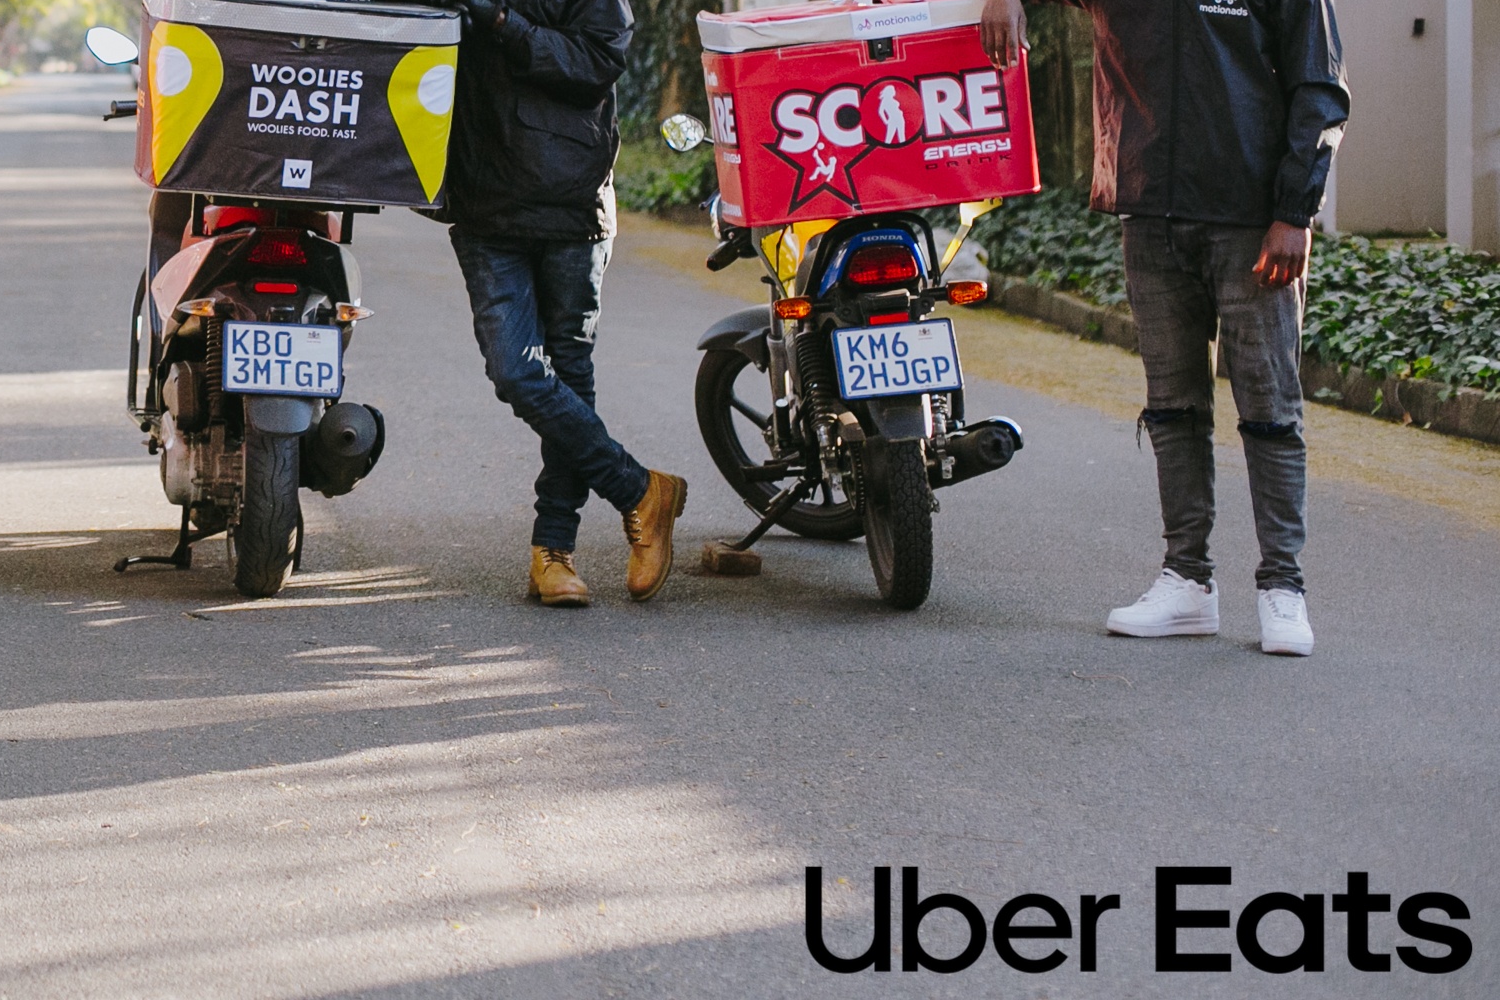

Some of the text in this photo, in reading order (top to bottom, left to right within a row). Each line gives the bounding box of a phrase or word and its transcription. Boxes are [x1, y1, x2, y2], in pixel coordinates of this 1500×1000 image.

[874, 12, 928, 28] motionads
[1200, 4, 1248, 17] motionads
[251, 63, 363, 90] WOOLIES
[248, 86, 360, 125] DASH
[776, 71, 1004, 153] SCORE
[247, 122, 357, 140] WOOLIES FOOD. FAST.
[924, 138, 1011, 160] ENERGY
[290, 168, 306, 179] W
[862, 235, 903, 243] HONDA
[847, 332, 909, 362] KM6
[233, 357, 333, 388] 3MTGP
[849, 356, 950, 392] 2HJGP
